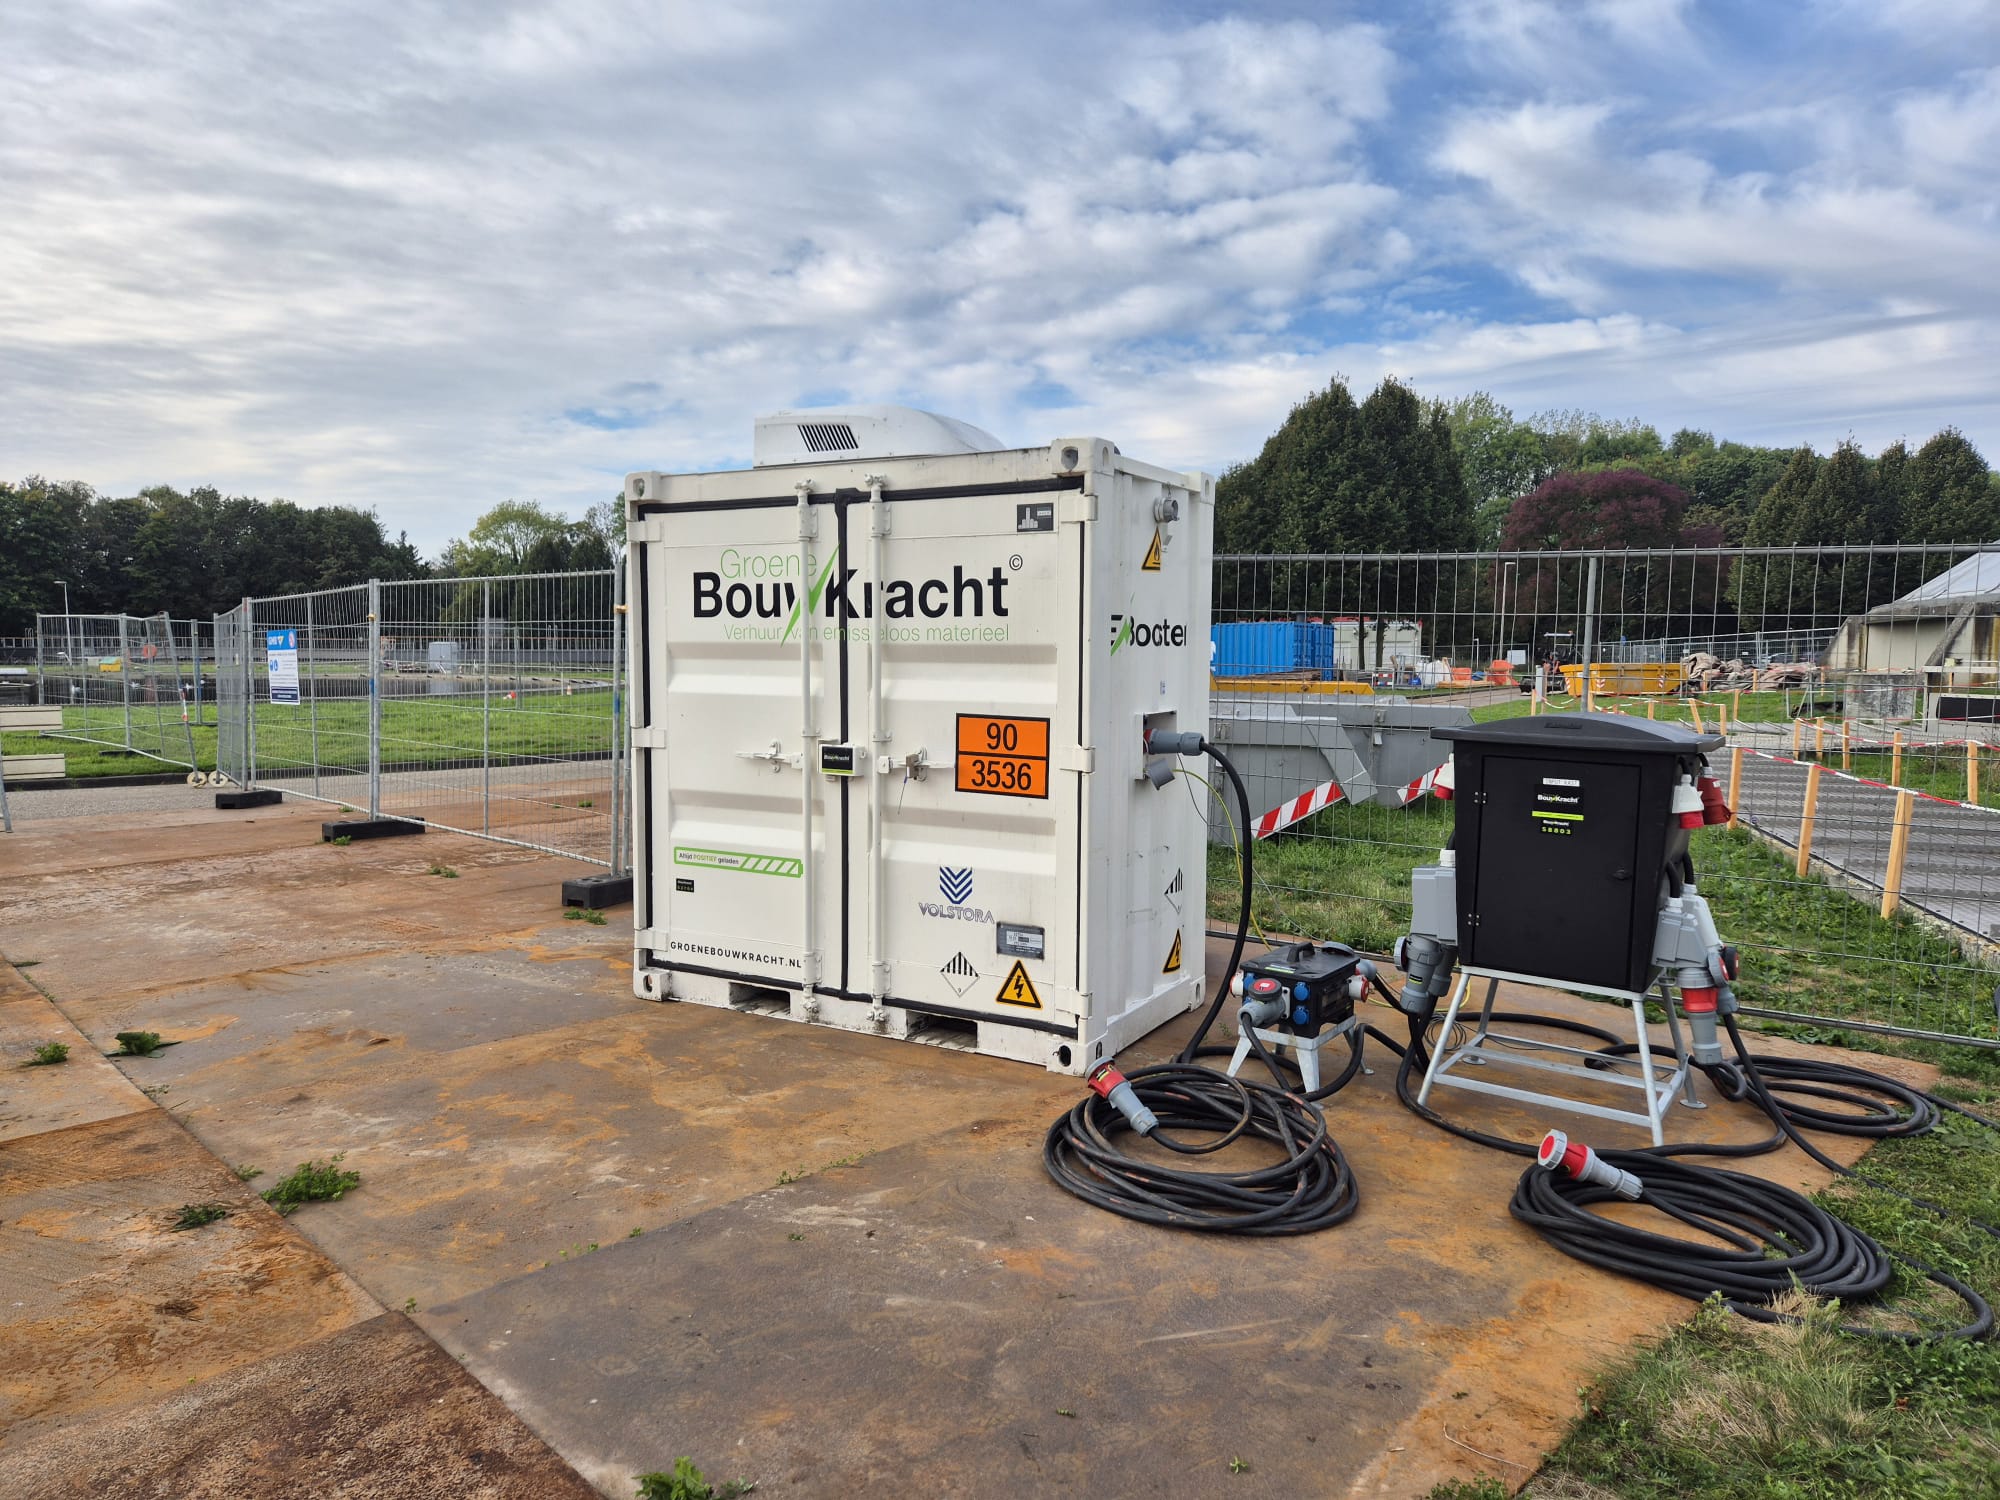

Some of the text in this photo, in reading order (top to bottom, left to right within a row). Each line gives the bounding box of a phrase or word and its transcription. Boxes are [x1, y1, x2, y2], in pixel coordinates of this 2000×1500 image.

[720, 549, 817, 578] Groene
[724, 623, 1009, 642] Verhuur vn emisseloos materieel
[986, 722, 1018, 751] 90
[971, 759, 1032, 791] 3536
[918, 902, 995, 924] VOLSTORA
[670, 941, 802, 968] GROENEBOUWKRACHT.NL
